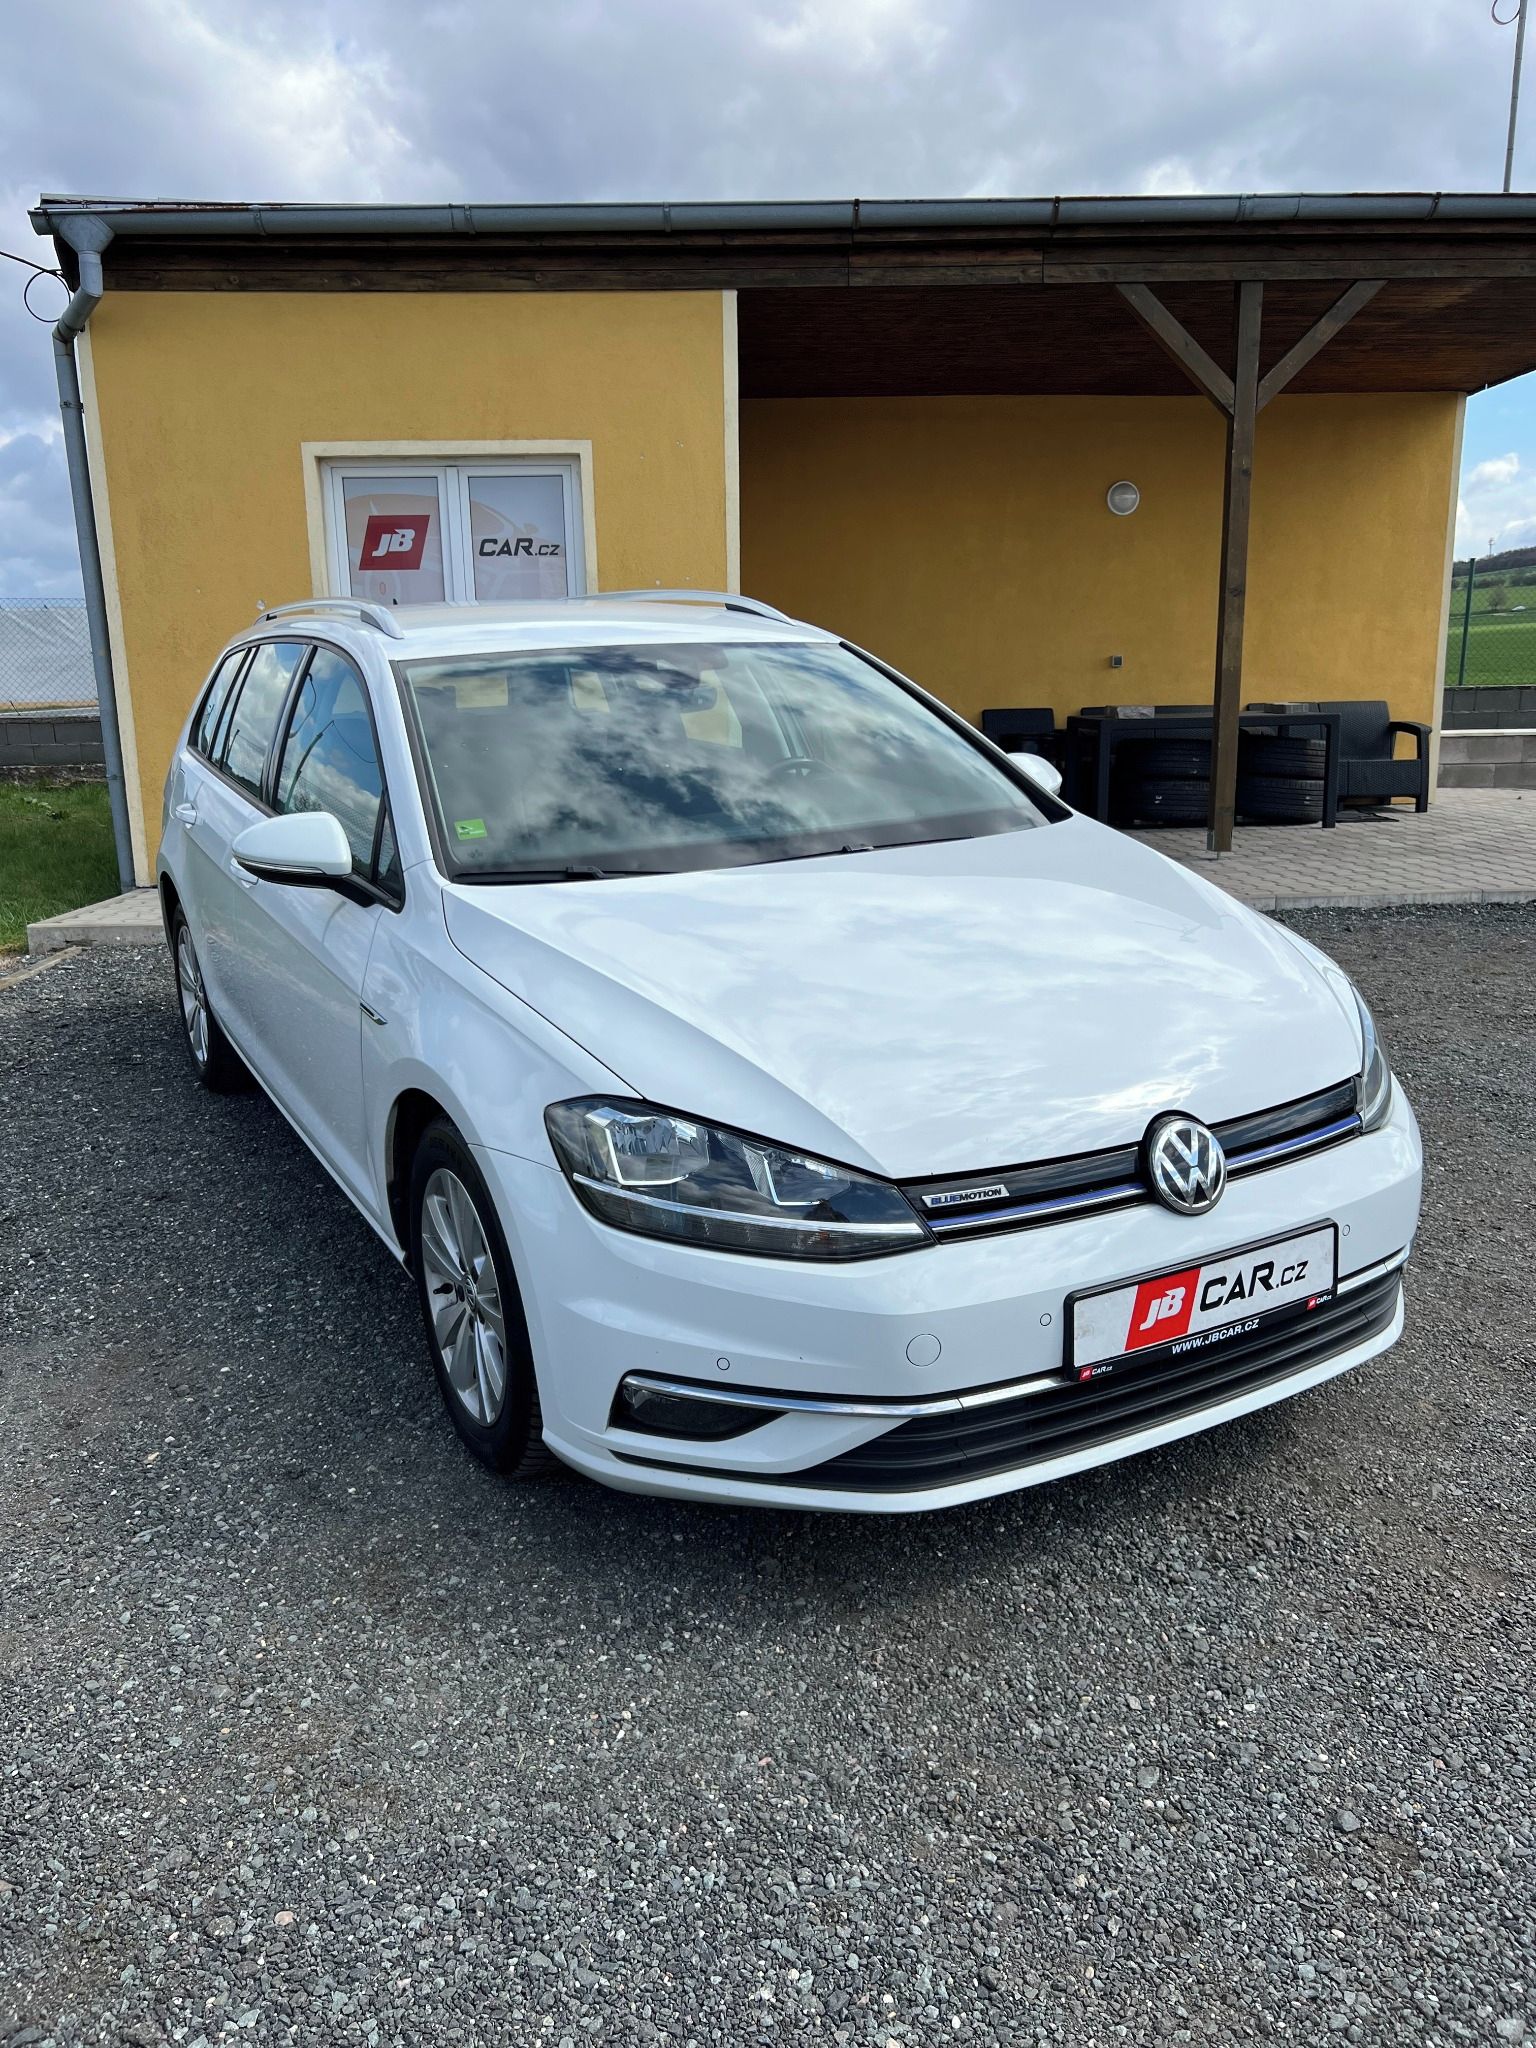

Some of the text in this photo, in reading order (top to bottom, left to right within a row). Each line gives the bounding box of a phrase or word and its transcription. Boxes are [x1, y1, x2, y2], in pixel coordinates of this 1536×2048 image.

[372, 528, 415, 557] JB
[931, 1188, 1002, 1205] BLUEMOTION
[1140, 1287, 1186, 1331] JB
[1172, 1319, 1260, 1354] WWW.JBCAR.CZ
